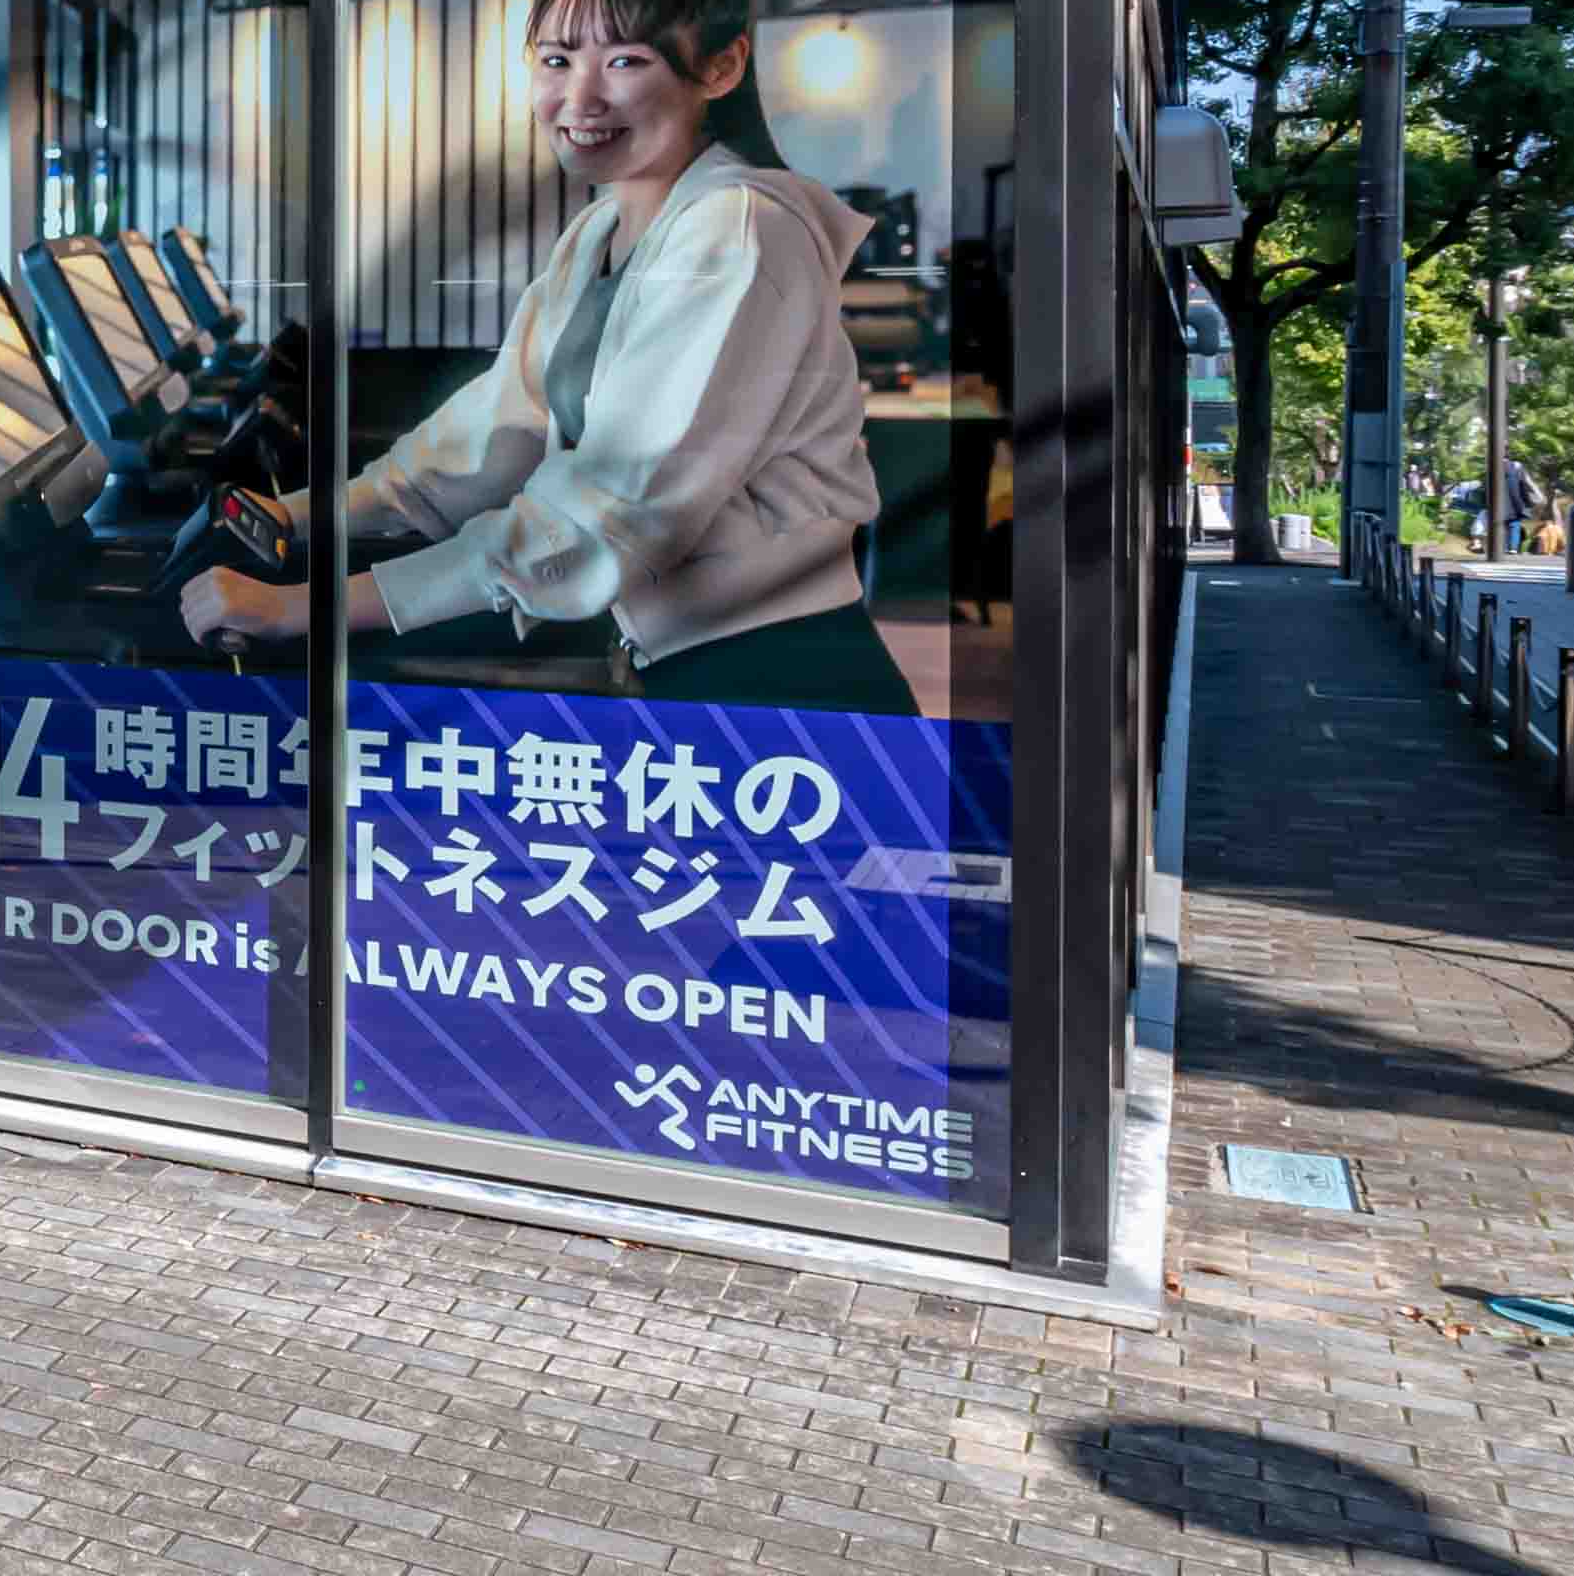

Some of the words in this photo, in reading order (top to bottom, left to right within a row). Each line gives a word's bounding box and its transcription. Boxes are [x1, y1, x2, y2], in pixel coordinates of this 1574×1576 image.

[97, 799, 836, 946] フィットネスジム
[51, 908, 220, 966] DOOR
[234, 921, 281, 974] is
[625, 973, 826, 1043] OPEN
[706, 1079, 974, 1142] ANYTIME
[706, 1115, 974, 1181] FITNESS
